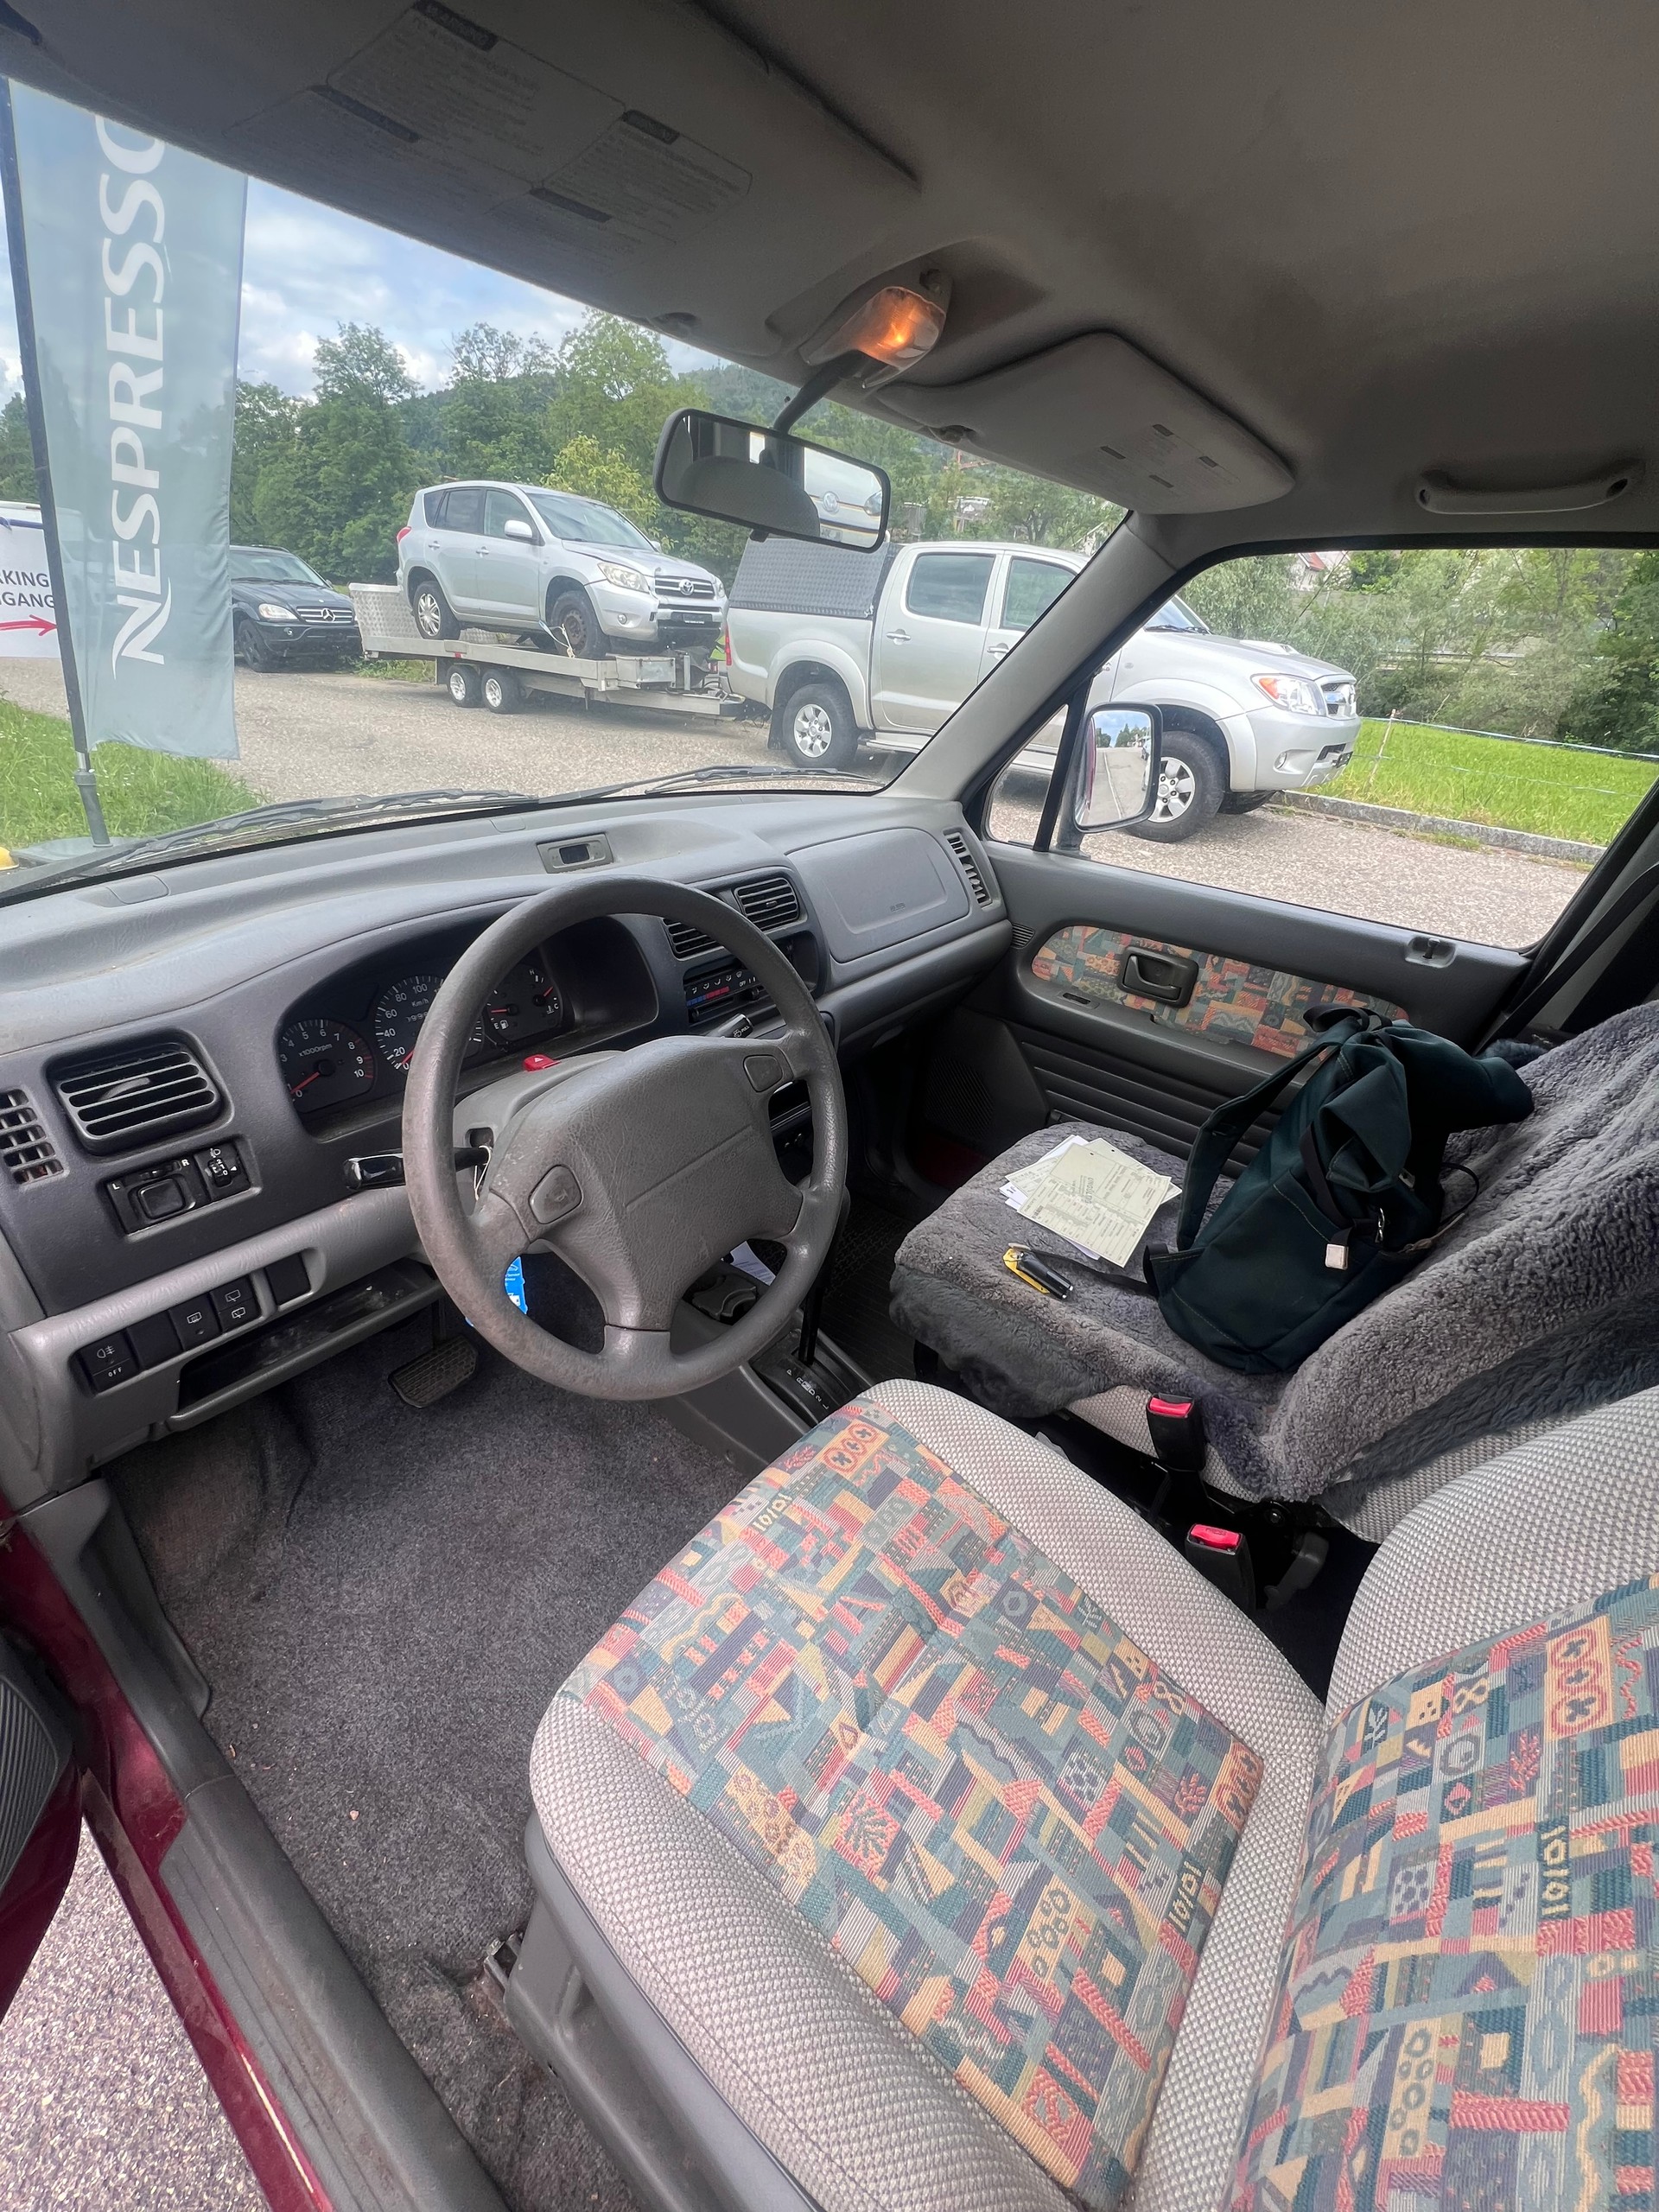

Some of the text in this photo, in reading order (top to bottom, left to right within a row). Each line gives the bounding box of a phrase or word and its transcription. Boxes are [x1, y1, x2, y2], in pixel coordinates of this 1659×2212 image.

[0, 569, 50, 588] KING
[0, 592, 55, 608] GANG
[412, 983, 429, 995] 100
[395, 992, 407, 1002] 80
[385, 1008, 397, 1019] 60
[302, 1031, 309, 1040] 5
[320, 1028, 327, 1037] 6
[334, 1033, 340, 1041] 7
[384, 1027, 396, 1038] 40
[347, 1041, 355, 1050] 8
[393, 1046, 405, 1057] 20
[280, 1053, 288, 1063] 3
[356, 1056, 364, 1065] 9
[403, 1062, 410, 1071] 0
[353, 1069, 365, 1078] 10
[295, 1089, 303, 1097] 0
[111, 1181, 120, 1191] L
[108, 1366, 122, 1377] OFF
